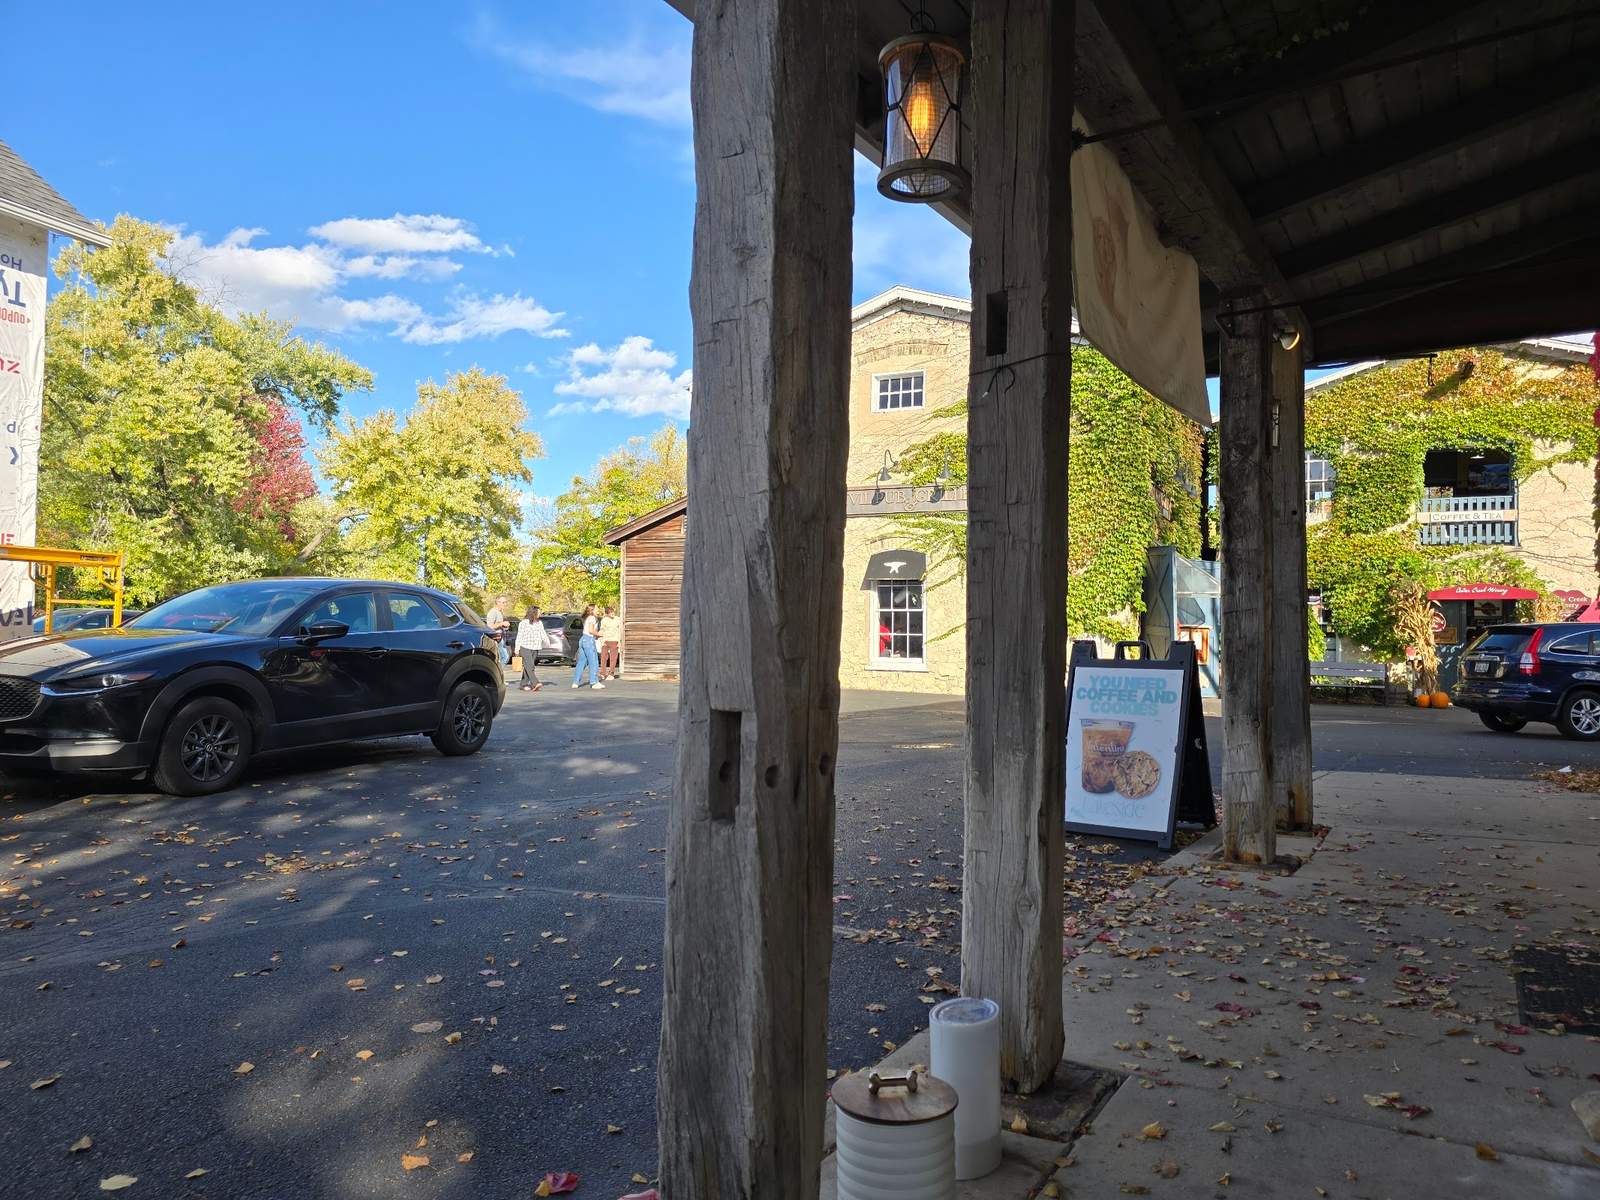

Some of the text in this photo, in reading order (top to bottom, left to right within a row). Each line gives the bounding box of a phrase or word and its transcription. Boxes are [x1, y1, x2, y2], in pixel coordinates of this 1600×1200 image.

[1432, 511, 1503, 521] COFFEE & TEA
[1089, 674, 1168, 690] YOU NEED
[1076, 687, 1178, 704] COFFEE AND
[1089, 701, 1159, 717] COOKIES
